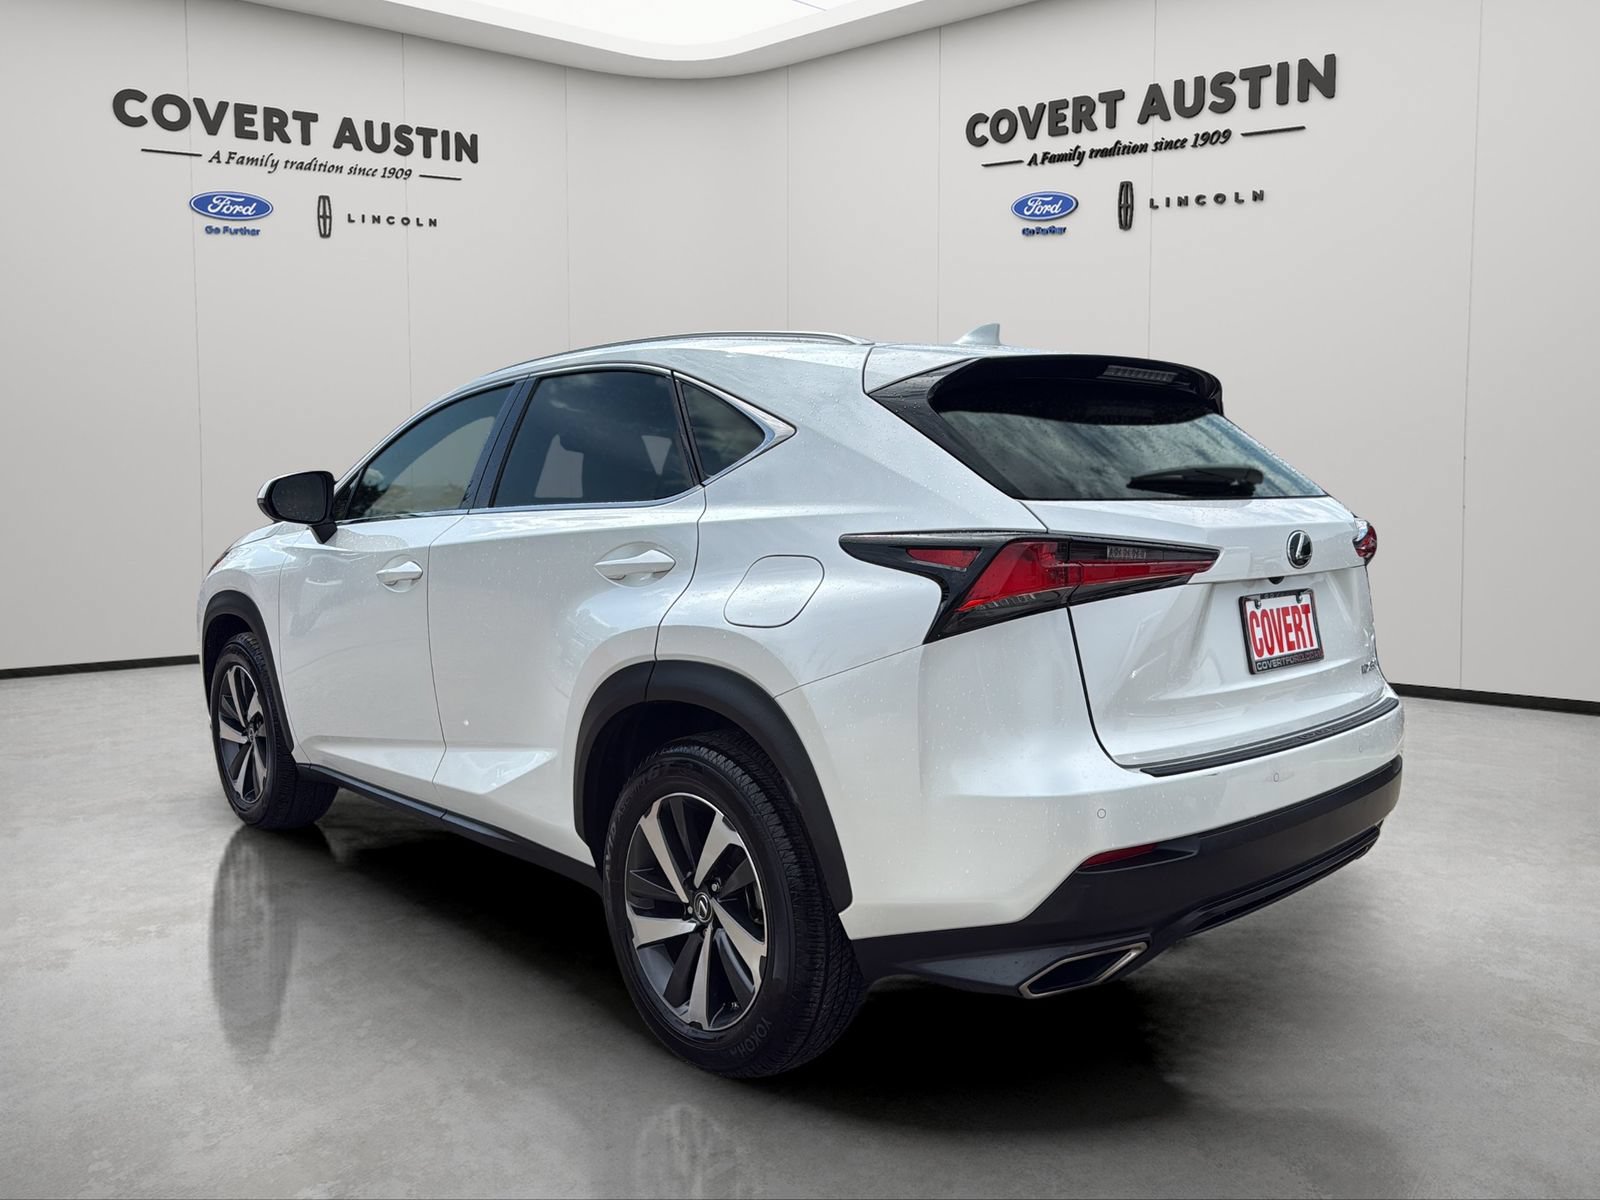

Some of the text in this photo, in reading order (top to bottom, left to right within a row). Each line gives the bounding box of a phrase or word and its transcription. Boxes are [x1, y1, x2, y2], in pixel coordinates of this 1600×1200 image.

[965, 53, 1337, 148] COVERT AUSTIN
[112, 88, 479, 164] COVERT AUSTIN
[1026, 128, 1233, 168] A Family tradition since 1909
[207, 150, 413, 181] A Family tradition since 1909
[207, 195, 258, 216] Ford
[1023, 196, 1063, 216] Ford
[1149, 189, 1266, 210] LINCOLN
[347, 213, 438, 228] LINCOLN
[1249, 603, 1314, 658] COVERT
